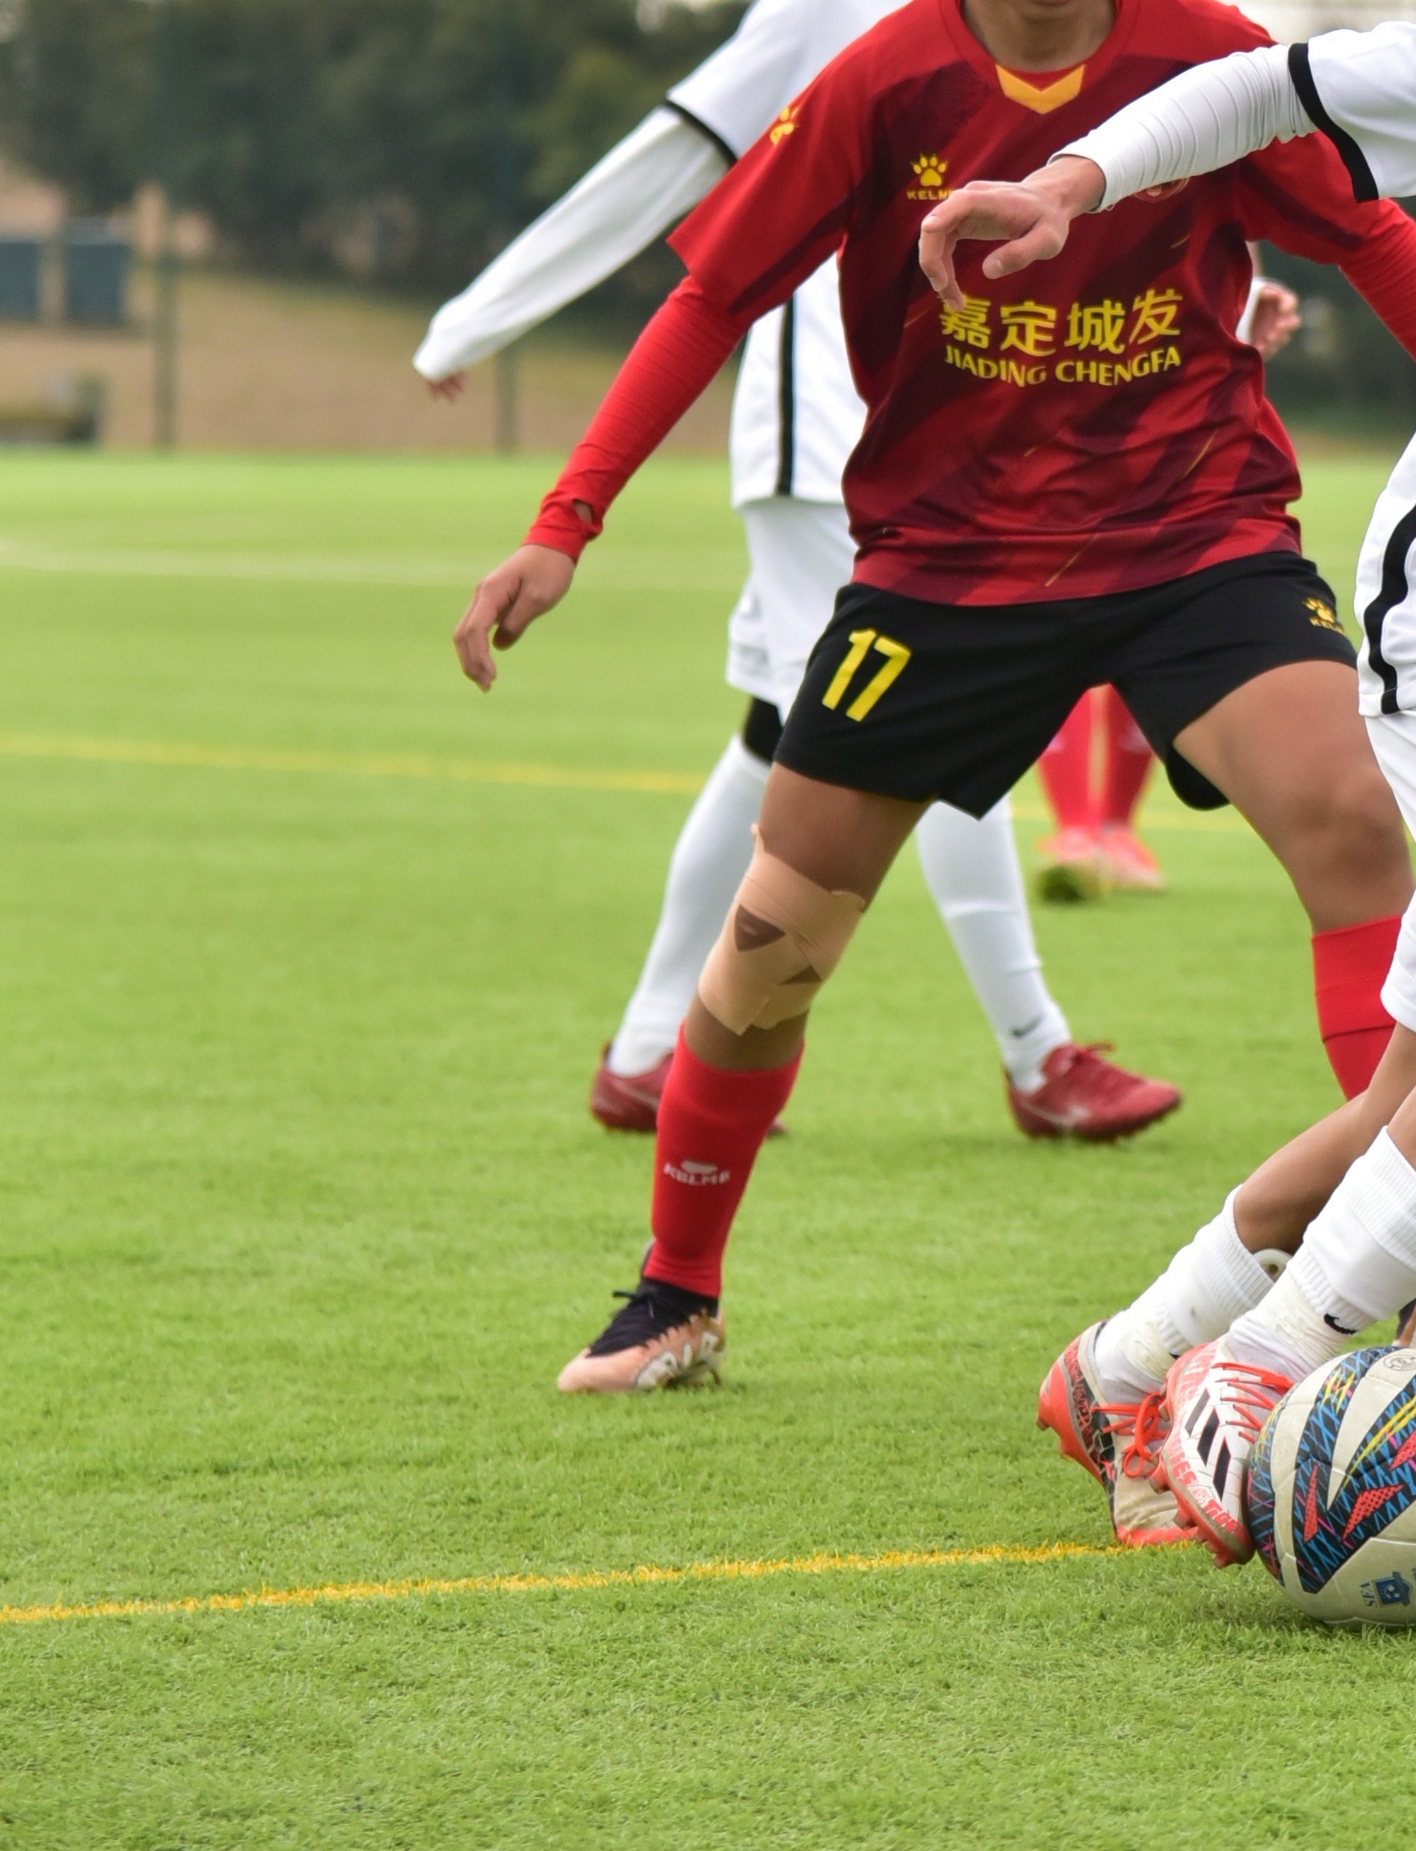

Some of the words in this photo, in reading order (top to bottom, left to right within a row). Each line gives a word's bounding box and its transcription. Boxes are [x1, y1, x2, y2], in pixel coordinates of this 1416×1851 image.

[906, 189, 954, 201] KELM
[938, 288, 1183, 357] 嘉定城发
[944, 345, 1047, 388] JIADING
[1055, 346, 1182, 387] CHENGFA
[821, 629, 912, 722] 17
